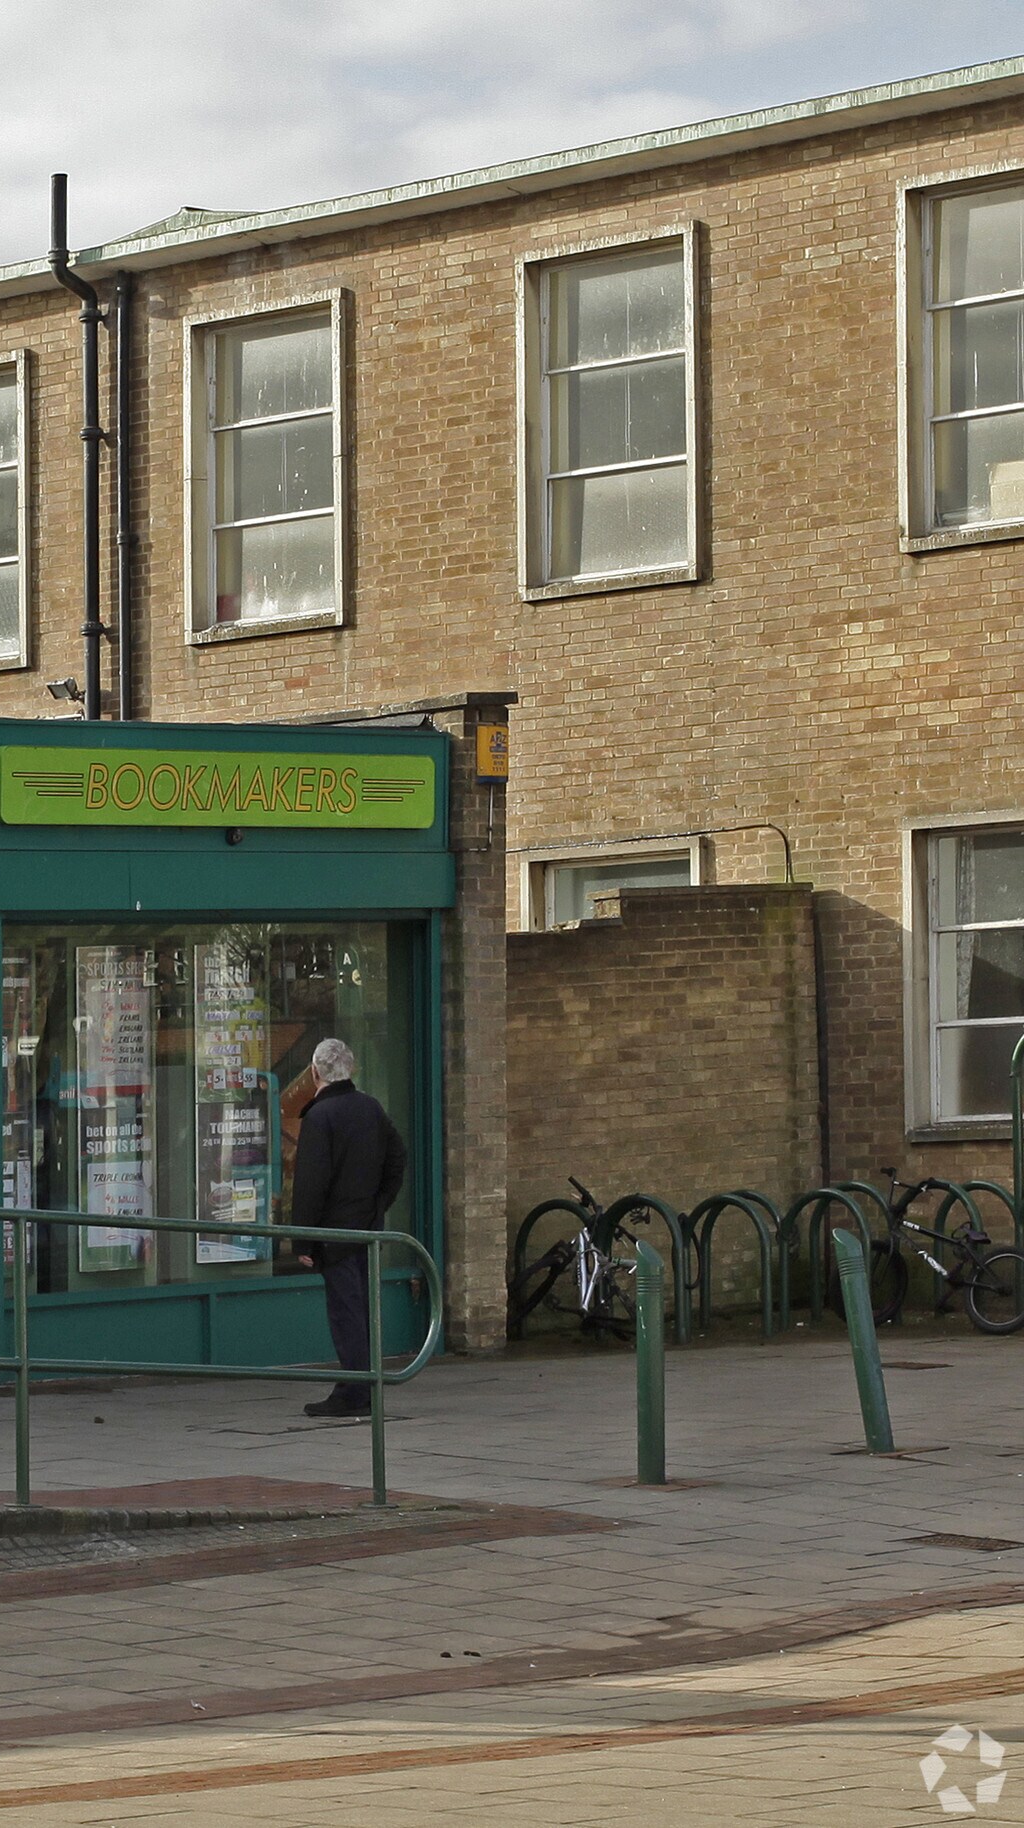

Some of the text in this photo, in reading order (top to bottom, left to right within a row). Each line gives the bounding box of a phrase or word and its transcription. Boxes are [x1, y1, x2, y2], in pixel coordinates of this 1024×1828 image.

[84, 762, 358, 813] BOOKMAKERS
[86, 1126, 104, 1138] bet
[105, 1126, 118, 1137] on
[119, 1123, 130, 1136] all
[86, 1138, 129, 1155] sports
